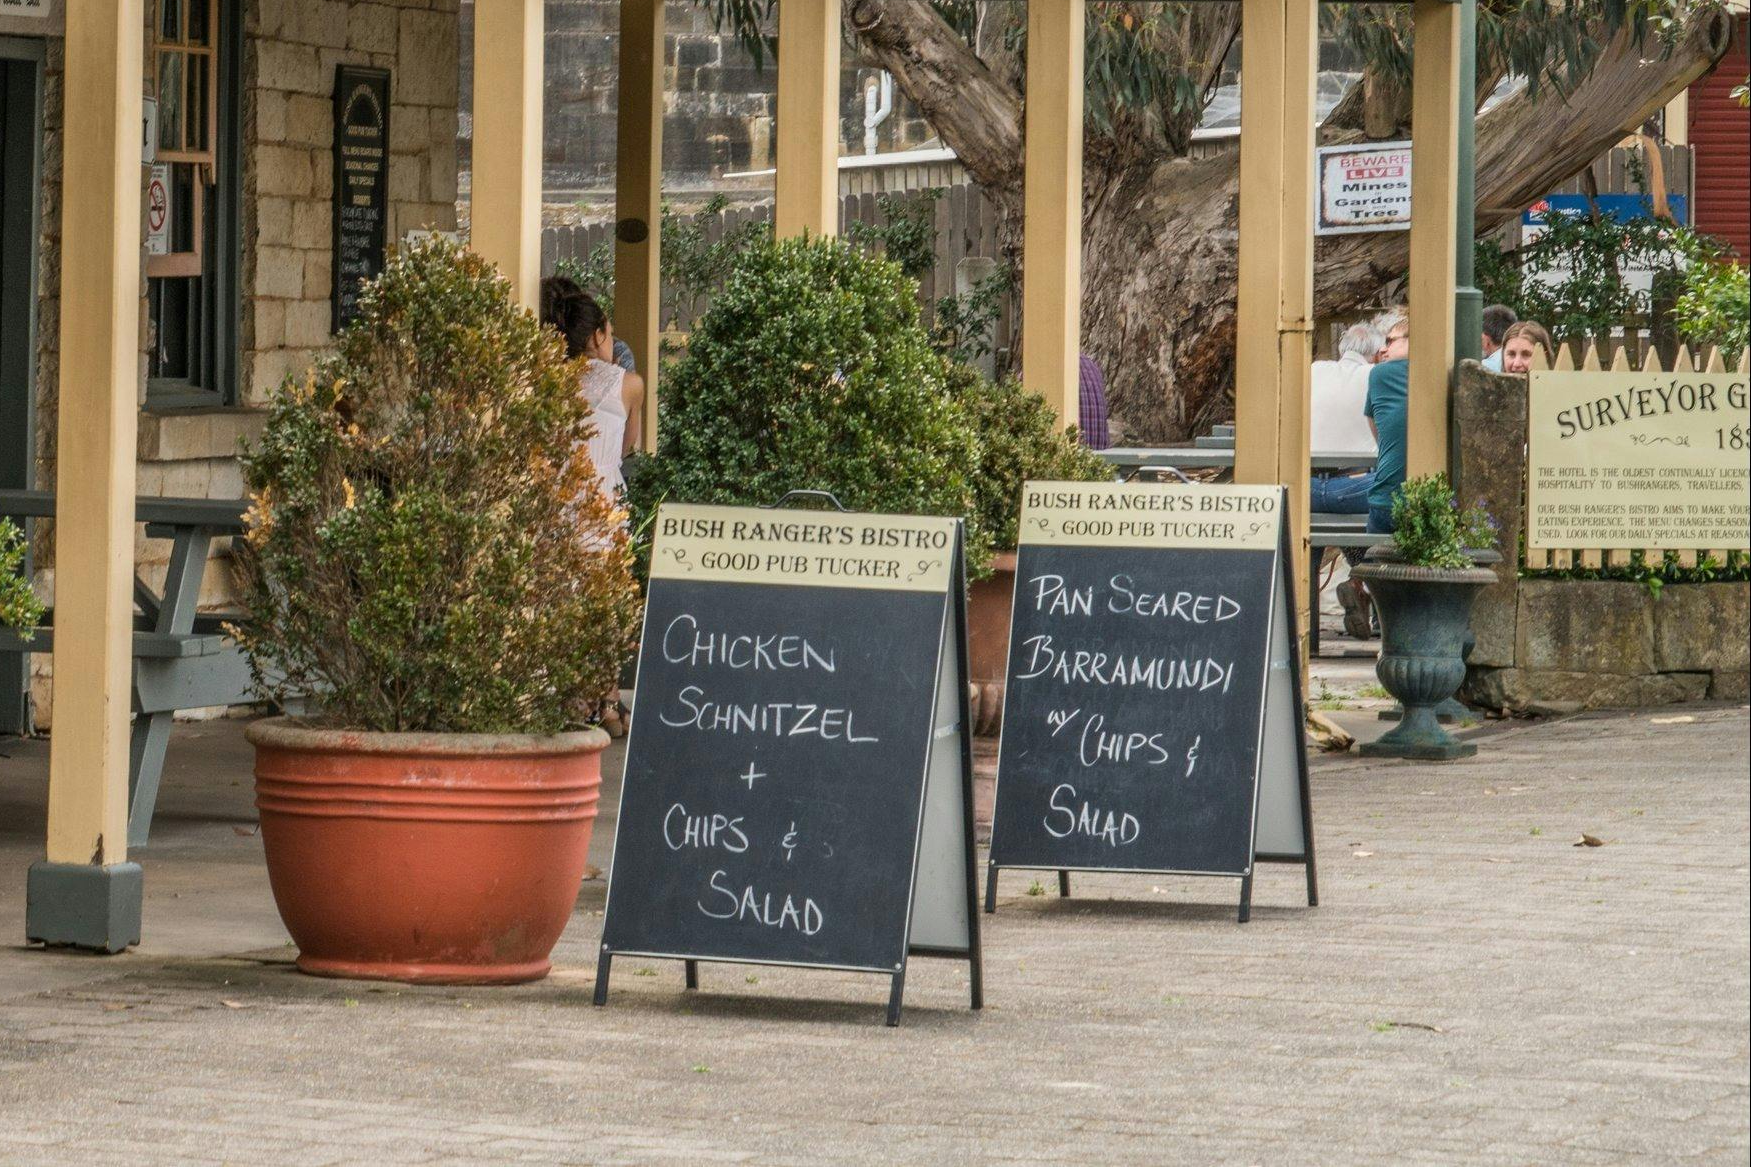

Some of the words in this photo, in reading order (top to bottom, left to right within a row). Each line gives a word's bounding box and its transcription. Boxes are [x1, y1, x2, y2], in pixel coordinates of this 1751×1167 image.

[1340, 154, 1409, 168] BEWARE
[1348, 167, 1403, 180] LIVE
[1342, 181, 1408, 192] Mines
[1350, 209, 1398, 219] Tree
[1556, 380, 1717, 439] SURVEYOR
[1538, 467, 1555, 477] THE
[1559, 467, 1586, 478] HOTEL
[1590, 467, 1599, 477] IS
[1602, 468, 1619, 478] THE
[1622, 468, 1655, 478] OLDEST
[1658, 468, 1716, 478] CONTINUALLY
[1537, 479, 1595, 490] HOSPITALITY
[1599, 480, 1612, 490] TO
[1617, 480, 1682, 491] BUSHRANGERS,
[1687, 480, 1744, 492] TRAVELLERS,
[1029, 493, 1081, 509] BUSH
[1087, 493, 1194, 512] RANGER'S
[1199, 496, 1275, 513] BISTRO
[1537, 504, 1555, 515] OUR
[1558, 504, 1581, 515] BUSH
[1584, 504, 1626, 515] RANGER'S
[1629, 504, 1660, 515] BISTRO
[1663, 505, 1684, 515] AIMS
[1688, 505, 1698, 515] TO
[1701, 505, 1725, 515] MAKE
[663, 518, 724, 539] BUSH
[731, 520, 854, 545] RANGER'S
[860, 526, 948, 549] BISTRO
[1062, 520, 1113, 536] GOOD
[1117, 521, 1155, 537] PUB
[1163, 522, 1235, 539] TUCKER
[1537, 517, 1569, 527] EATING
[1571, 517, 1624, 527] EXPERIENCE.
[1630, 517, 1646, 527] THE
[1649, 517, 1671, 527] MENU
[1673, 517, 1713, 527] CHANGES
[1715, 517, 1750, 527] SEASON
[1537, 529, 1562, 539] USED.
[1566, 529, 1588, 539] LOOK
[1590, 529, 1607, 539] FOR
[1608, 529, 1626, 539] OUR
[1627, 529, 1653, 539] DAILY
[1654, 529, 1696, 540] SPECIALS
[1697, 530, 1708, 540] AT
[701, 552, 760, 570] GOOD
[766, 555, 809, 574] PUB
[815, 557, 901, 579] TUCKER
[1029, 574, 1093, 616] PAN
[1108, 573, 1241, 624] SEARED
[662, 613, 836, 673] CHICKEN
[1016, 634, 1234, 694] BARRAMUNDI
[1080, 713, 1169, 767] CHIPS
[740, 761, 768, 790] +
[1043, 783, 1140, 847] SALAD
[663, 803, 749, 853] CHIPS
[697, 869, 823, 936] SALAD
